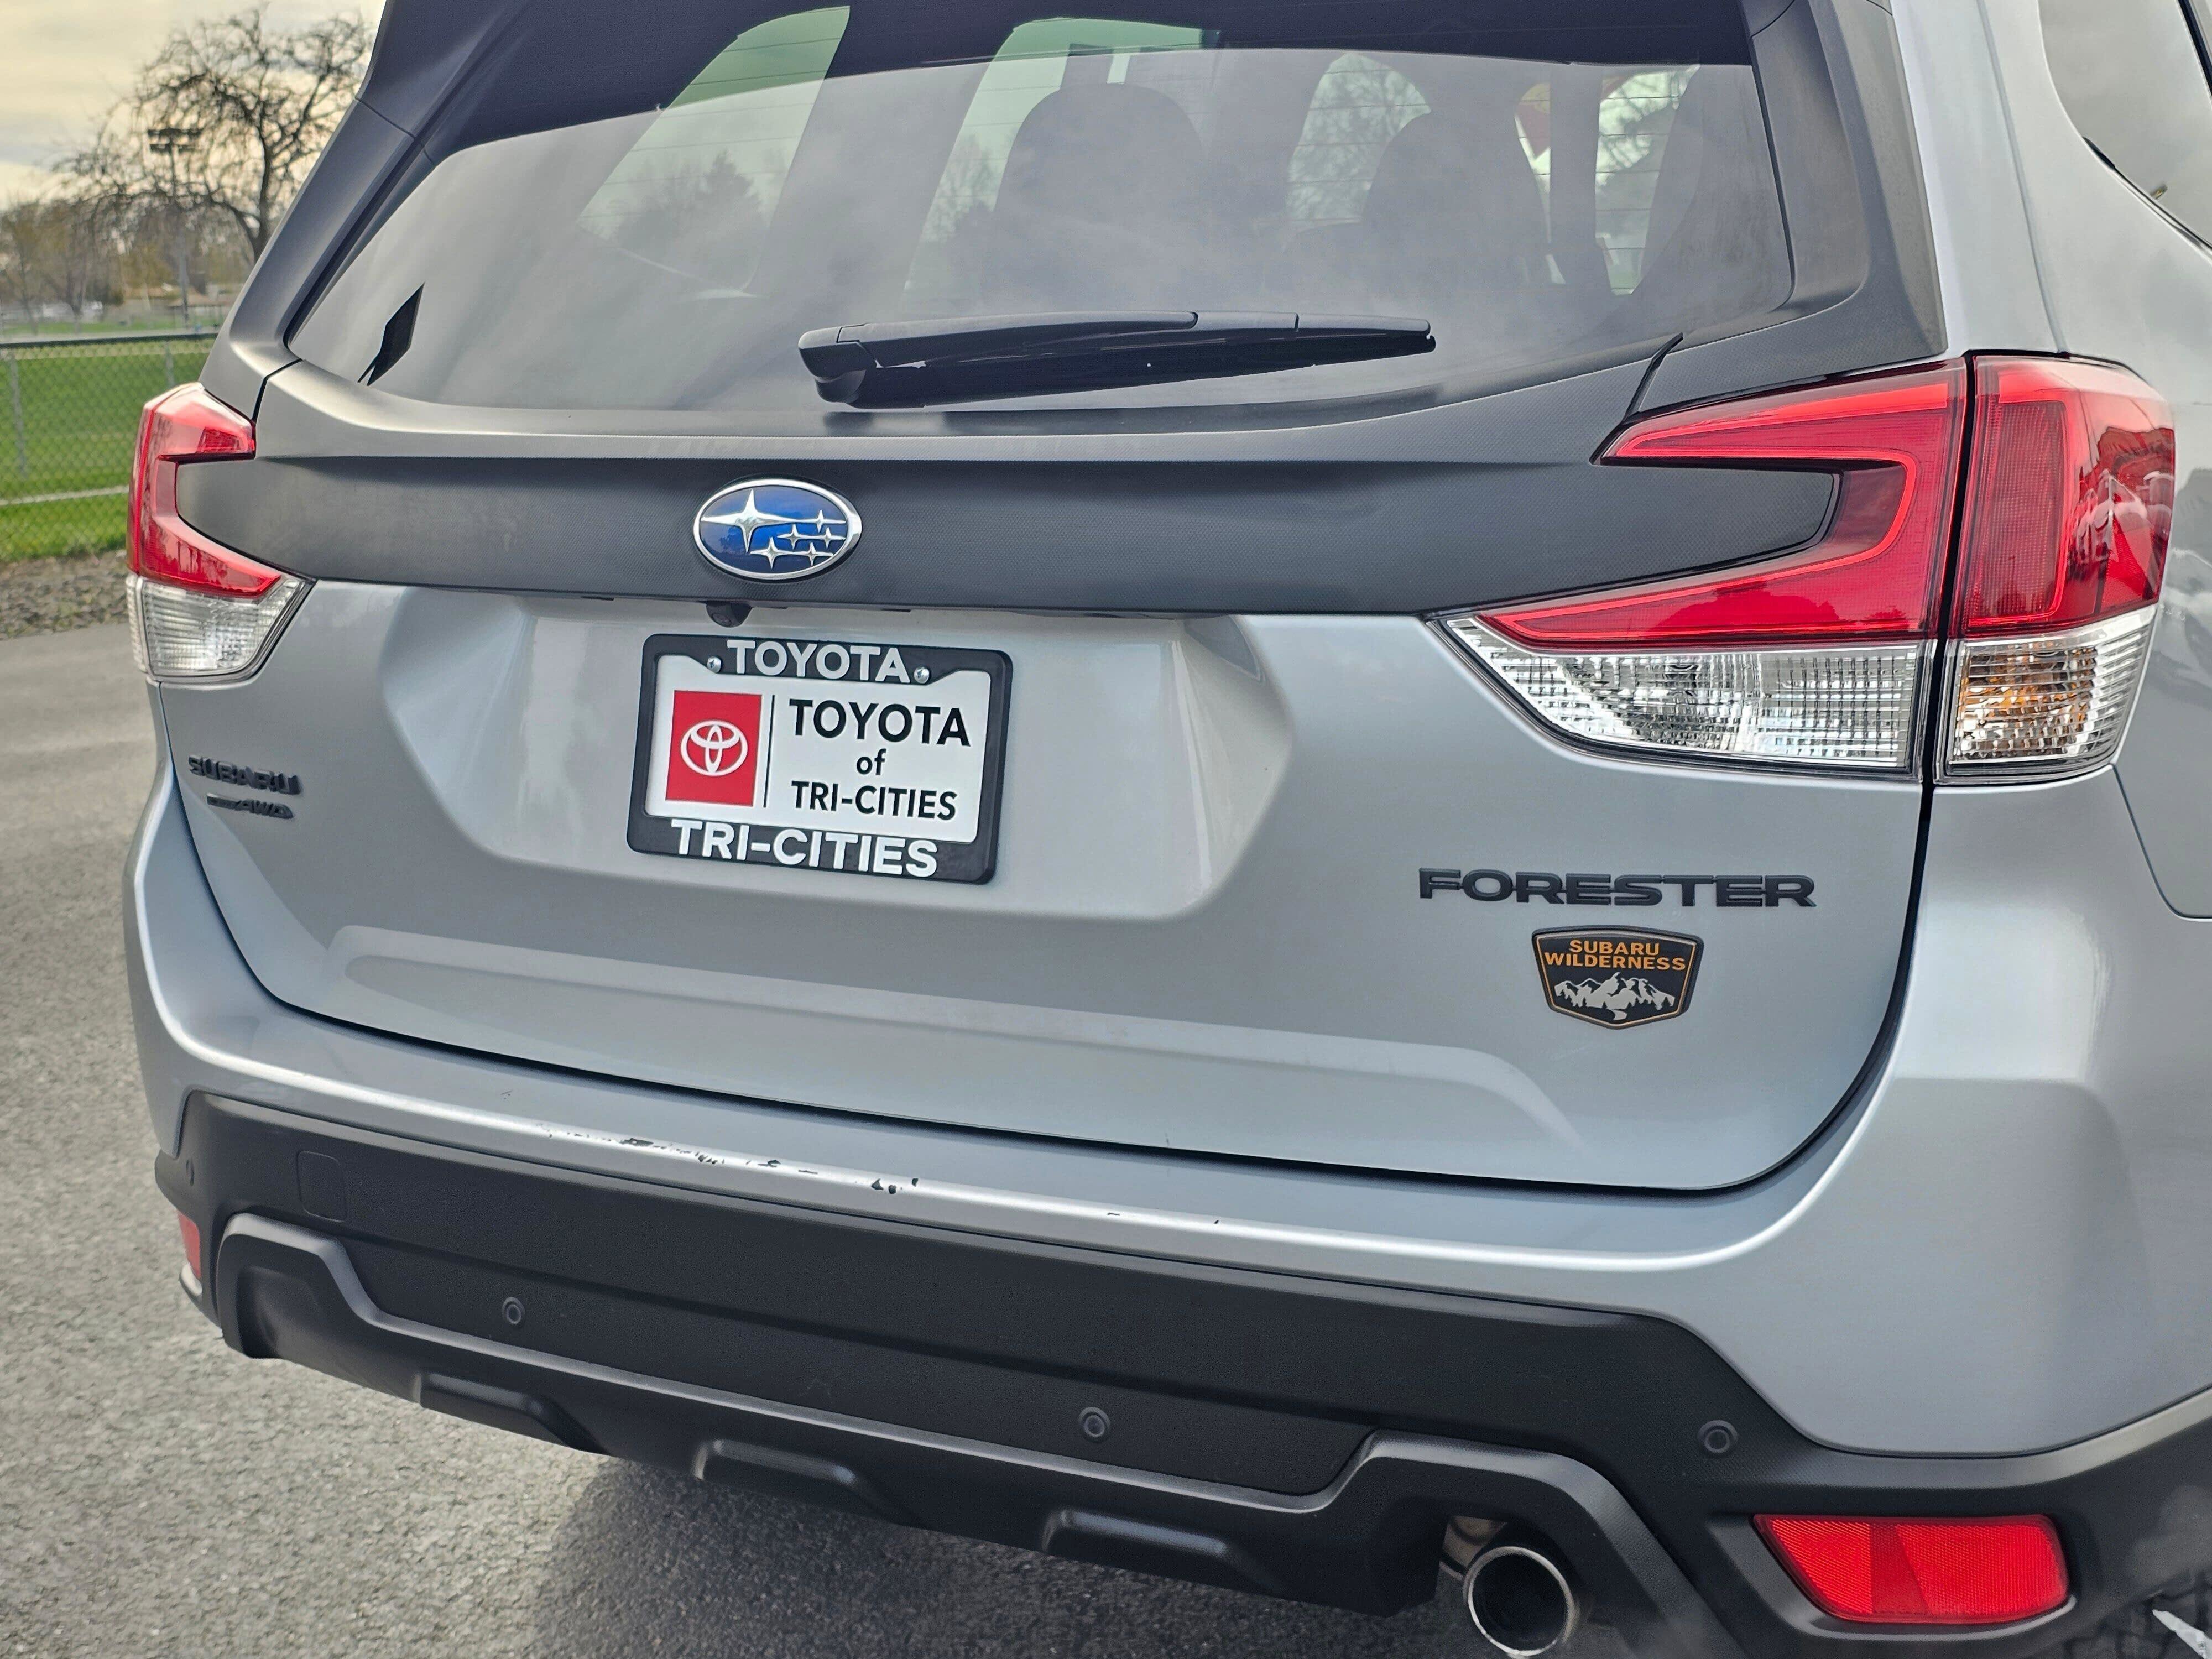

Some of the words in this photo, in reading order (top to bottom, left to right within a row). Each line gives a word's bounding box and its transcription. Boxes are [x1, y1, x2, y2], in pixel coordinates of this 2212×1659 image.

[727, 640, 910, 683] TOYOTA
[789, 698, 970, 747] TOYOTA
[188, 755, 302, 795] SUBARU
[856, 749, 886, 775] of
[791, 780, 957, 820] TRI-CITIES
[671, 818, 937, 877] TRI-CITIES
[1419, 868, 1817, 907] FORESTER
[1545, 952, 1686, 971] WILDERNESS
[1569, 940, 1660, 956] SUBARU
